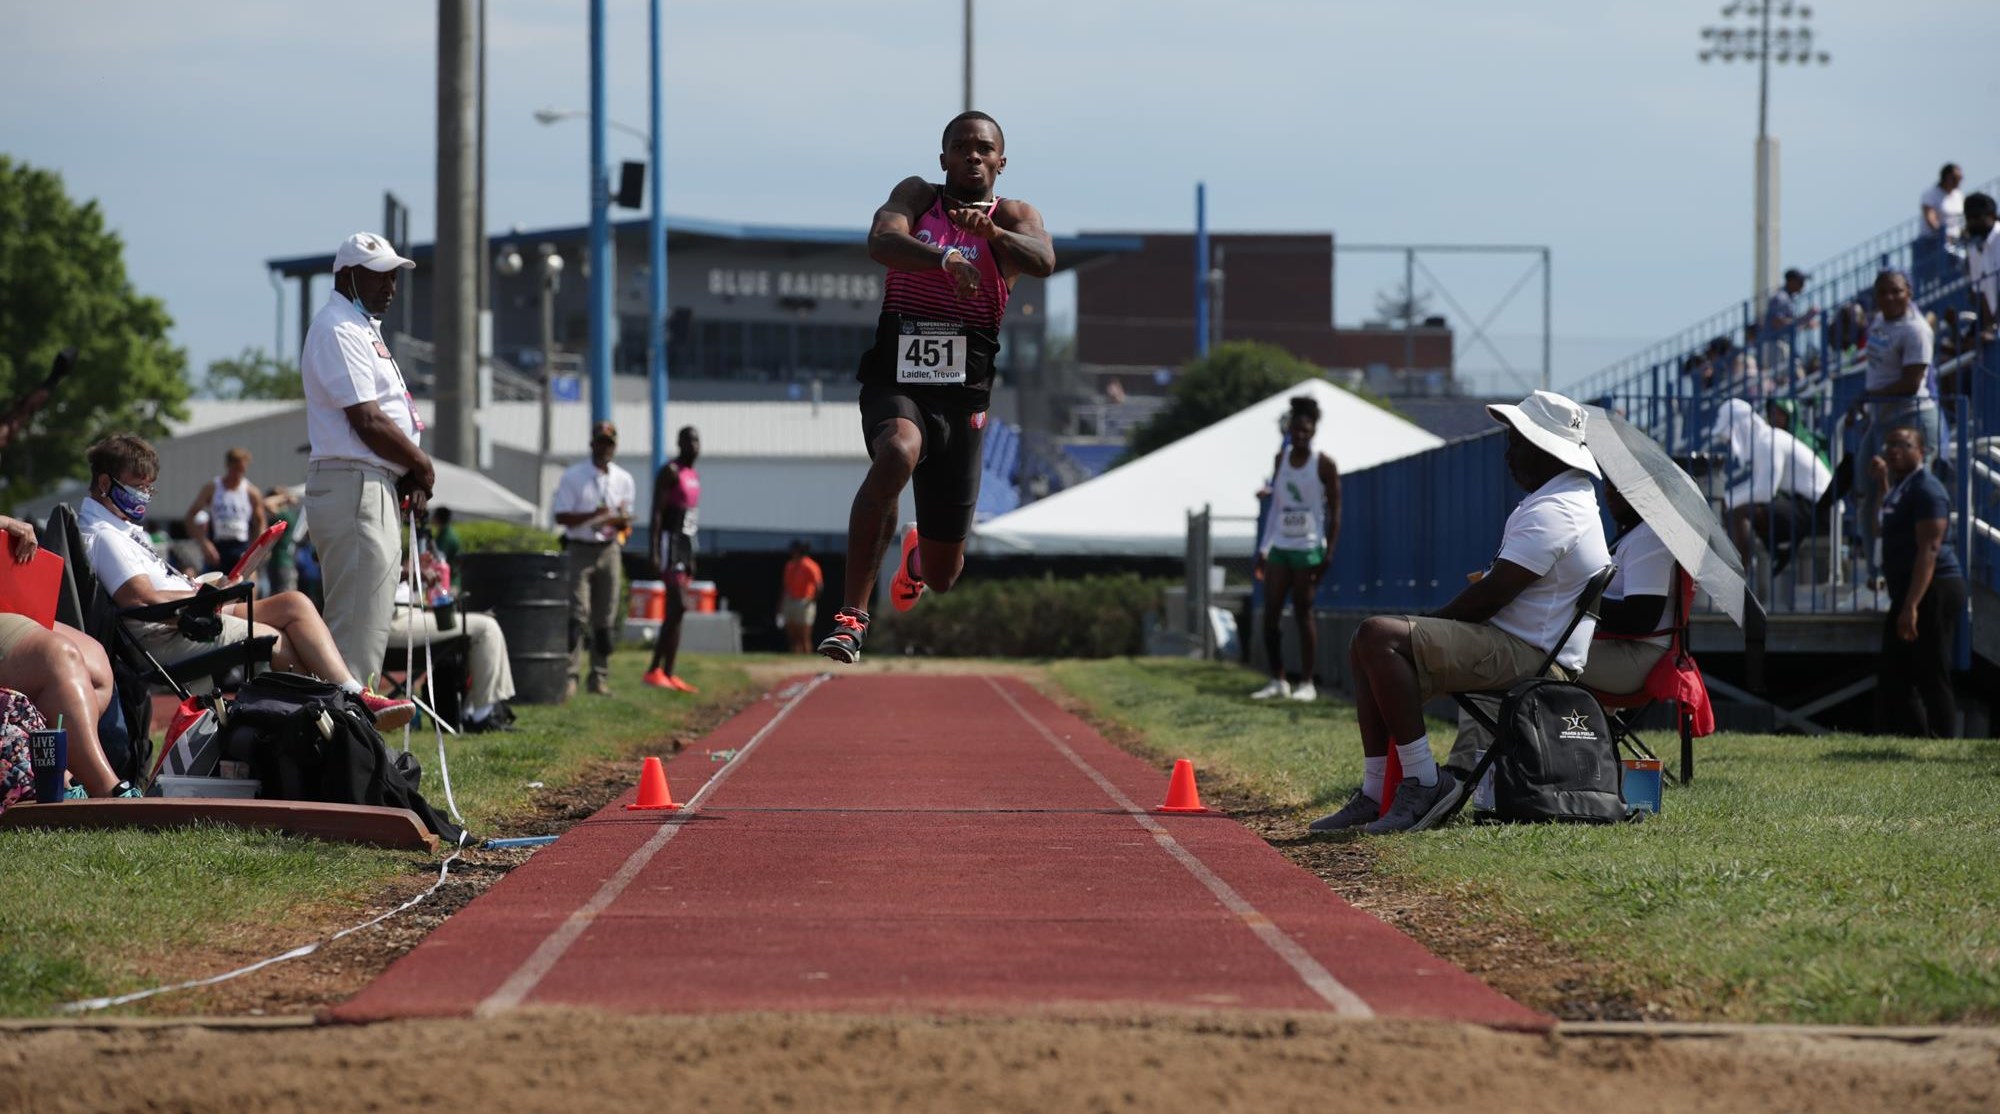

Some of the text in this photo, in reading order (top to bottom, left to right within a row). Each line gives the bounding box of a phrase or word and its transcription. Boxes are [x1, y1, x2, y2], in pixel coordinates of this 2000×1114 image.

[708, 269, 879, 299] BLUE RAIDERS
[905, 339, 954, 367] 451
[902, 370, 960, 379] Laidler, Trevon
[1571, 717, 1579, 726] V
[32, 735, 55, 748] LIVE
[33, 748, 56, 758] LVE
[34, 758, 56, 767] TEXAS
